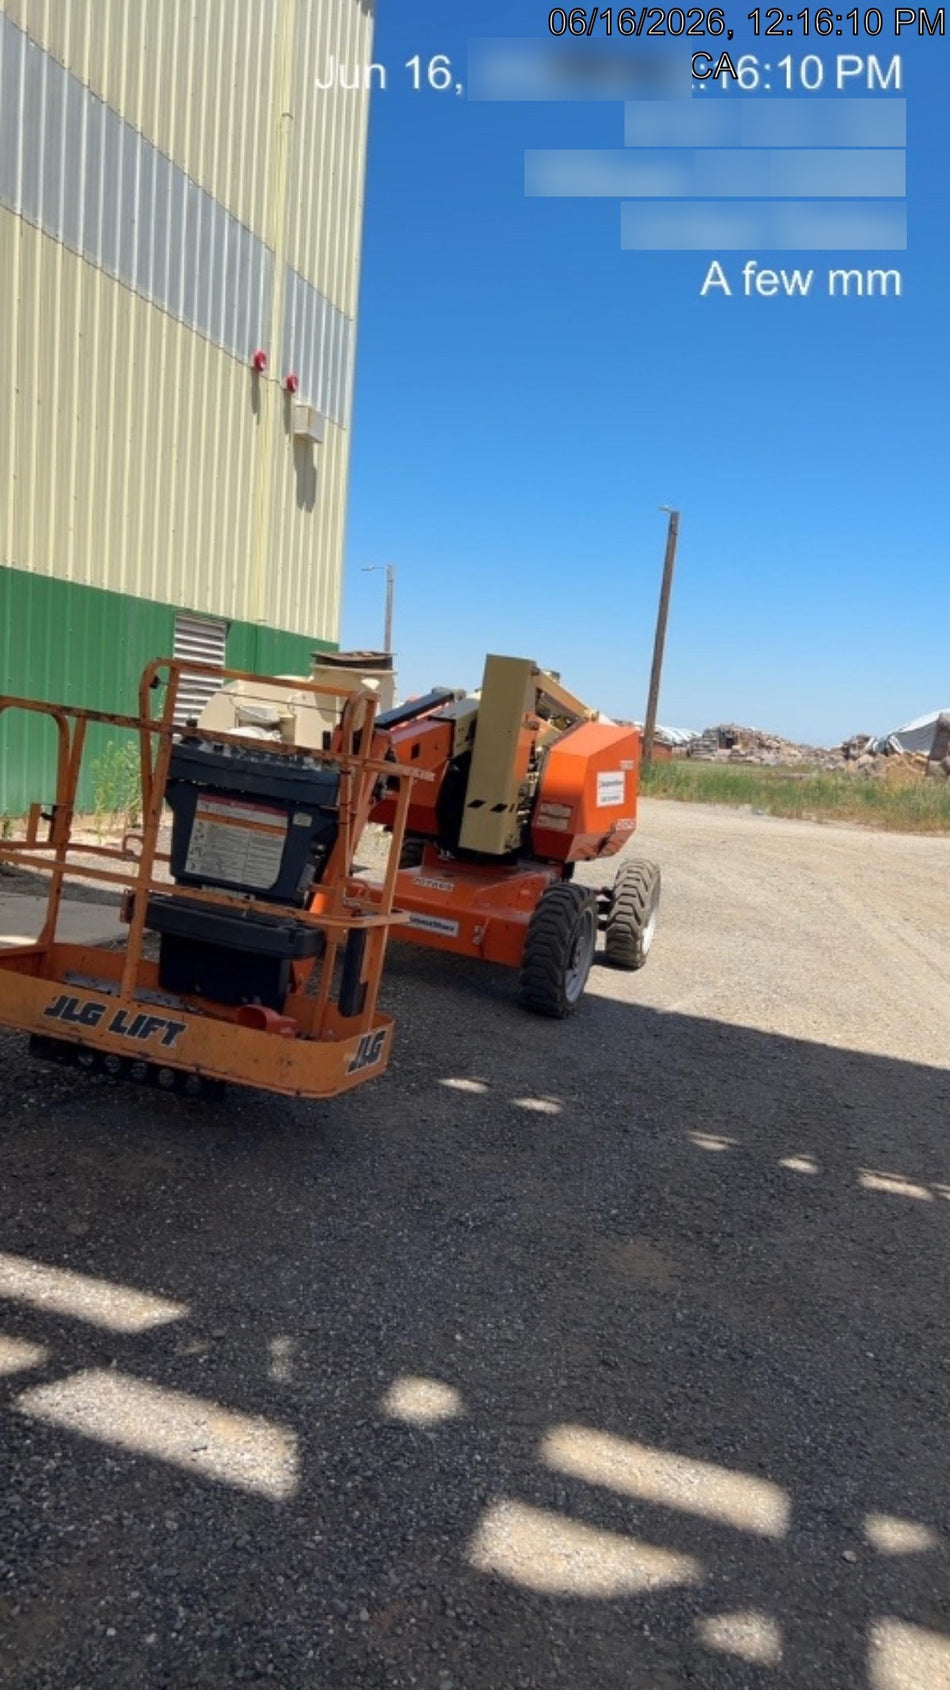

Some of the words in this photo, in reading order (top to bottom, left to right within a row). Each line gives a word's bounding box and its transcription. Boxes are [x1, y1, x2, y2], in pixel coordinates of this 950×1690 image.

[43, 995, 108, 1028] JLG
[107, 1009, 188, 1048] LIFT
[346, 1030, 386, 1074] JLG
